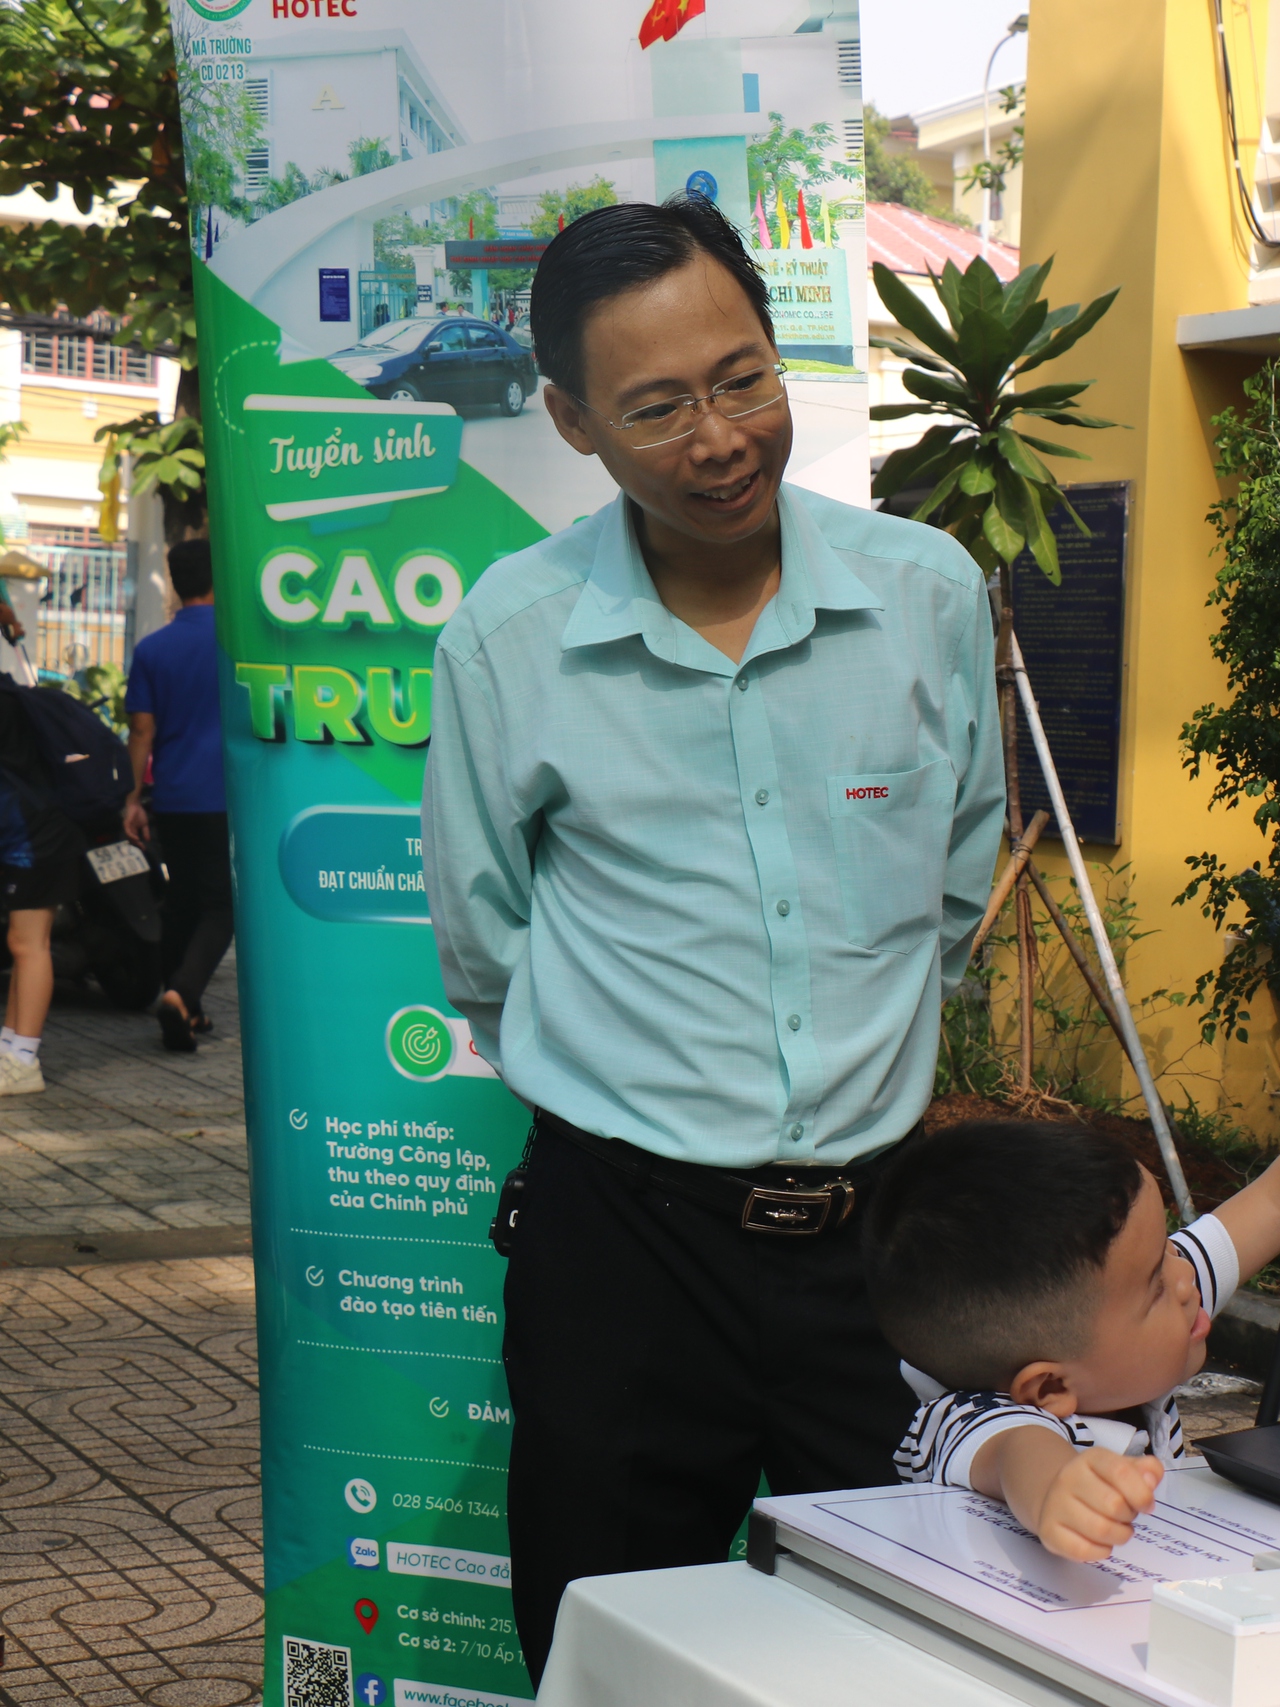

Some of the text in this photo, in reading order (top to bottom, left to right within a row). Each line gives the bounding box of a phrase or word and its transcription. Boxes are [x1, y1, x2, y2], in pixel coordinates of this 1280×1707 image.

[272, 0, 357, 18] HOTEC
[192, 36, 252, 56] MÃ TRƯỜNG
[216, 64, 244, 80] 0213
[769, 281, 832, 303] CHÍ MINH
[269, 422, 436, 478] Tuyển sinh
[260, 551, 463, 626] CAO
[236, 662, 432, 746] TRU
[846, 786, 889, 800] HOTEC
[319, 865, 426, 892] ĐẠT CHUẨN CHÂ
[325, 1116, 454, 1143] Học phí thấp:
[326, 1141, 490, 1171] Trường Công lập,
[328, 1167, 496, 1196] thu theo quy định
[329, 1190, 468, 1216] của Chính phủ
[338, 1269, 463, 1294] Chương trình
[340, 1296, 497, 1324] đào tạo tiên tiến
[468, 1400, 510, 1424] ĐẢM
[393, 1493, 499, 1518] 028 5406 1344
[355, 1546, 377, 1558] Zalo
[396, 1552, 451, 1570] HOTEC
[455, 1558, 486, 1576] Cao
[397, 1605, 512, 1633] Cơ sở chính: 215
[398, 1633, 421, 1647] Cơ
[423, 1635, 440, 1650] sở
[443, 1638, 456, 1652] 2:
[460, 1640, 491, 1658] 7/10
[493, 1642, 514, 1663] Ấp
